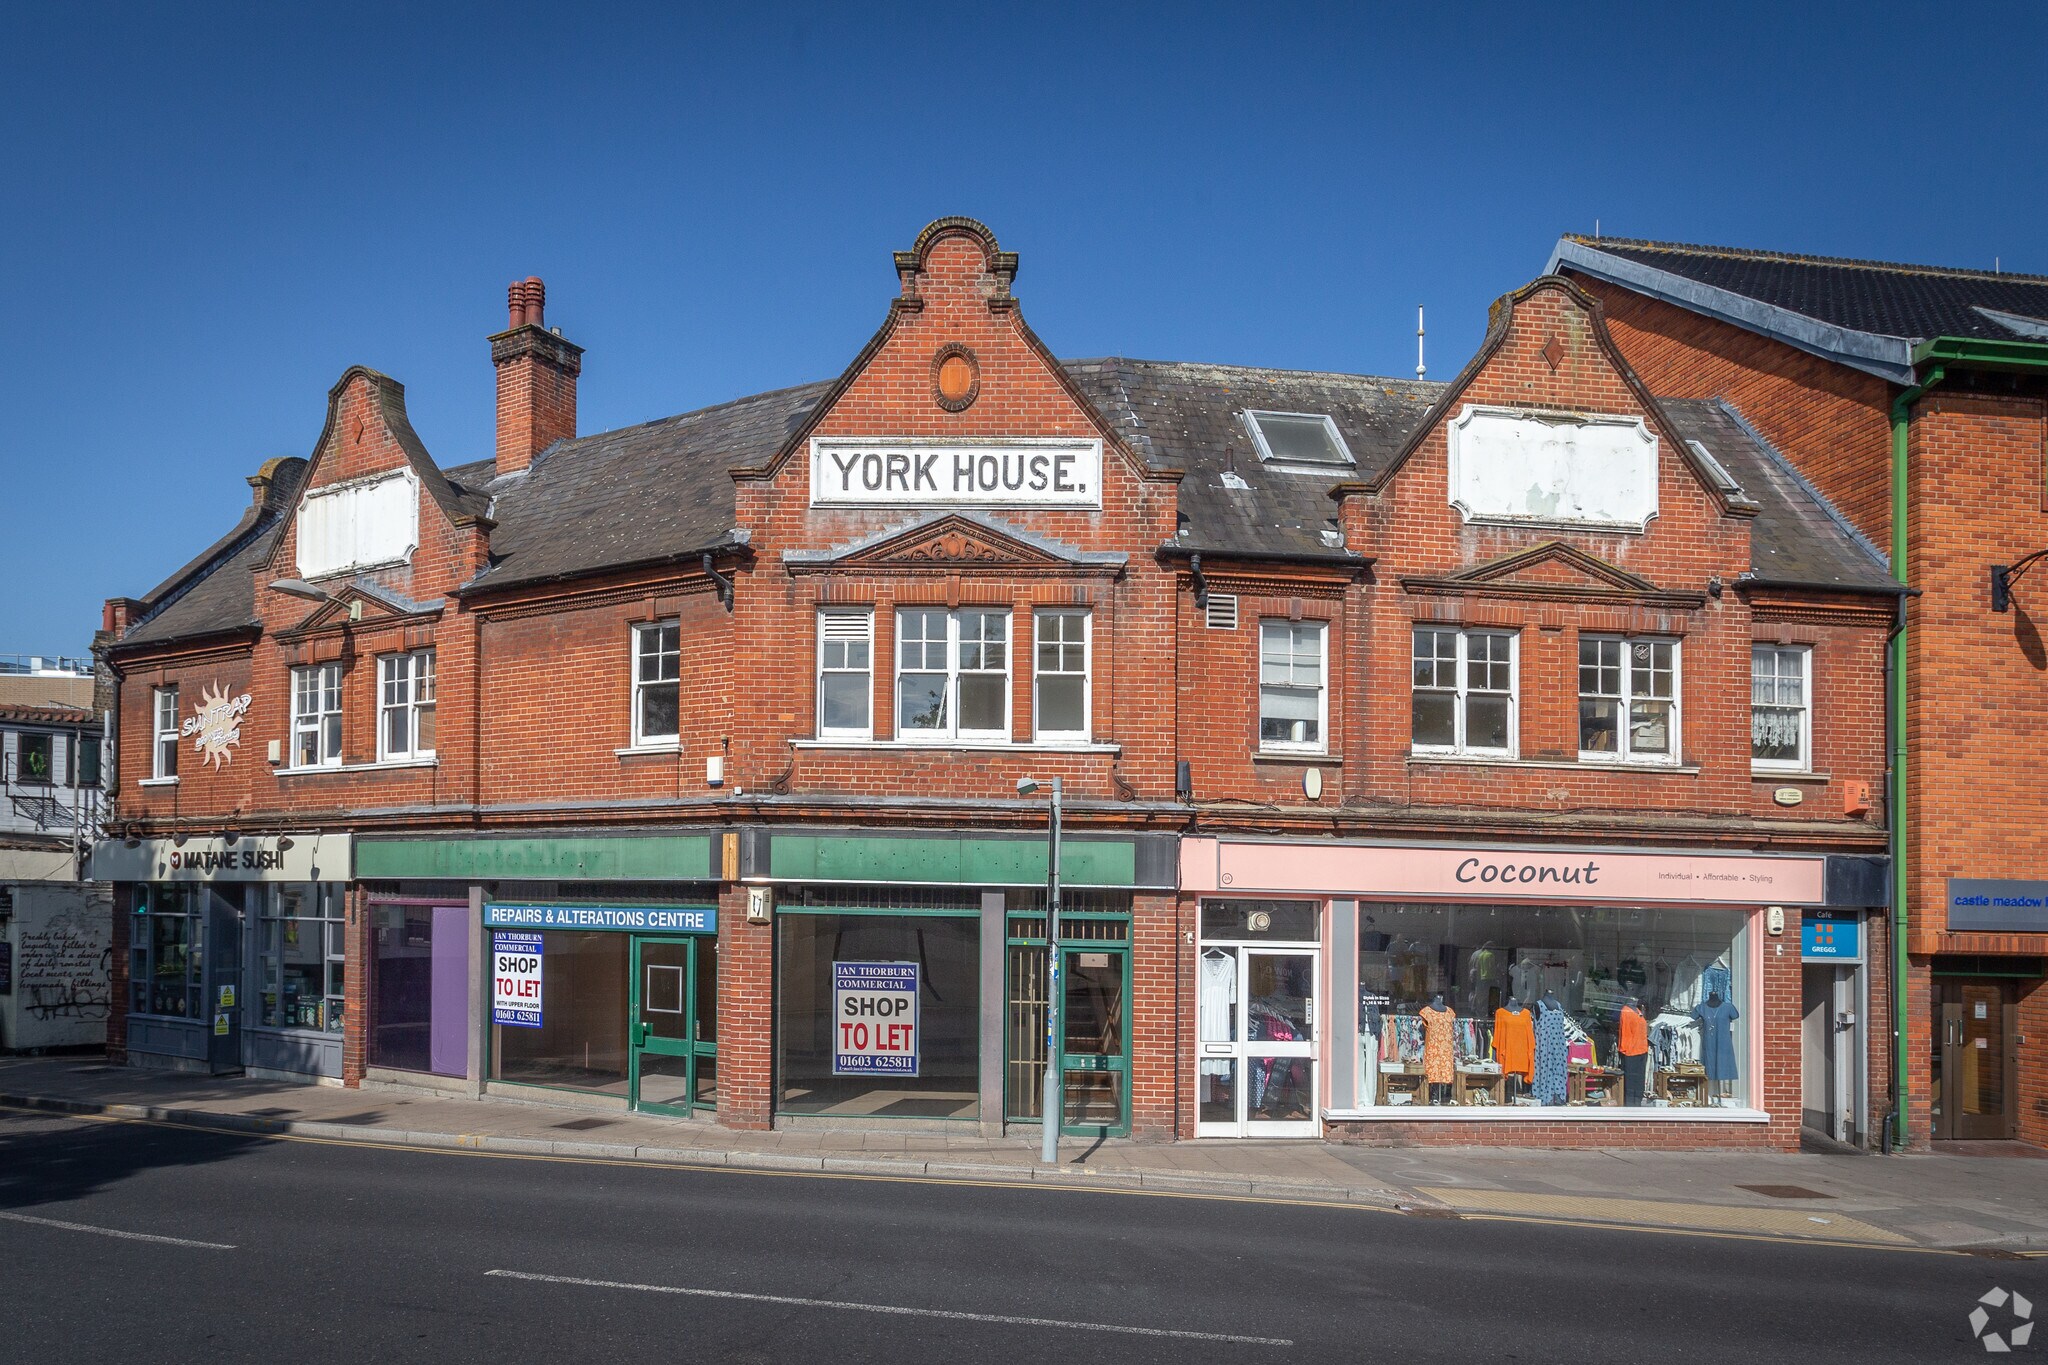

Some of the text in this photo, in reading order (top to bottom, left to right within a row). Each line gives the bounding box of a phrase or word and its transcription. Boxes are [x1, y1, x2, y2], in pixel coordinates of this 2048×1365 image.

[831, 453, 1086, 493] YORK HOUSE.
[181, 694, 252, 737] SUNTRAP
[184, 852, 238, 870] MATANE
[242, 851, 284, 870] SUSHI
[1455, 858, 1600, 884] Coconut
[1658, 872, 1773, 884] Individual Affordable Styling
[1954, 896, 1990, 906] castle
[1993, 896, 2041, 907] meadow
[492, 908, 705, 928] REPAIRS & ALTERATIONS CENTRE
[508, 933, 542, 941] THORBURN
[62, 941, 86, 951] filled
[495, 944, 536, 952] COMMERCIAL
[21, 959, 31, 970] of
[34, 959, 56, 970] daily
[499, 956, 538, 973] SHOP
[859, 967, 915, 976] THORBURN
[496, 978, 540, 998] TO LET
[838, 980, 906, 989] COMMERCIAL
[845, 996, 909, 1016] SHOP
[496, 1010, 540, 1022] 01603 625811
[841, 1023, 913, 1051] TO LET
[840, 1056, 912, 1068] 01603 625811
